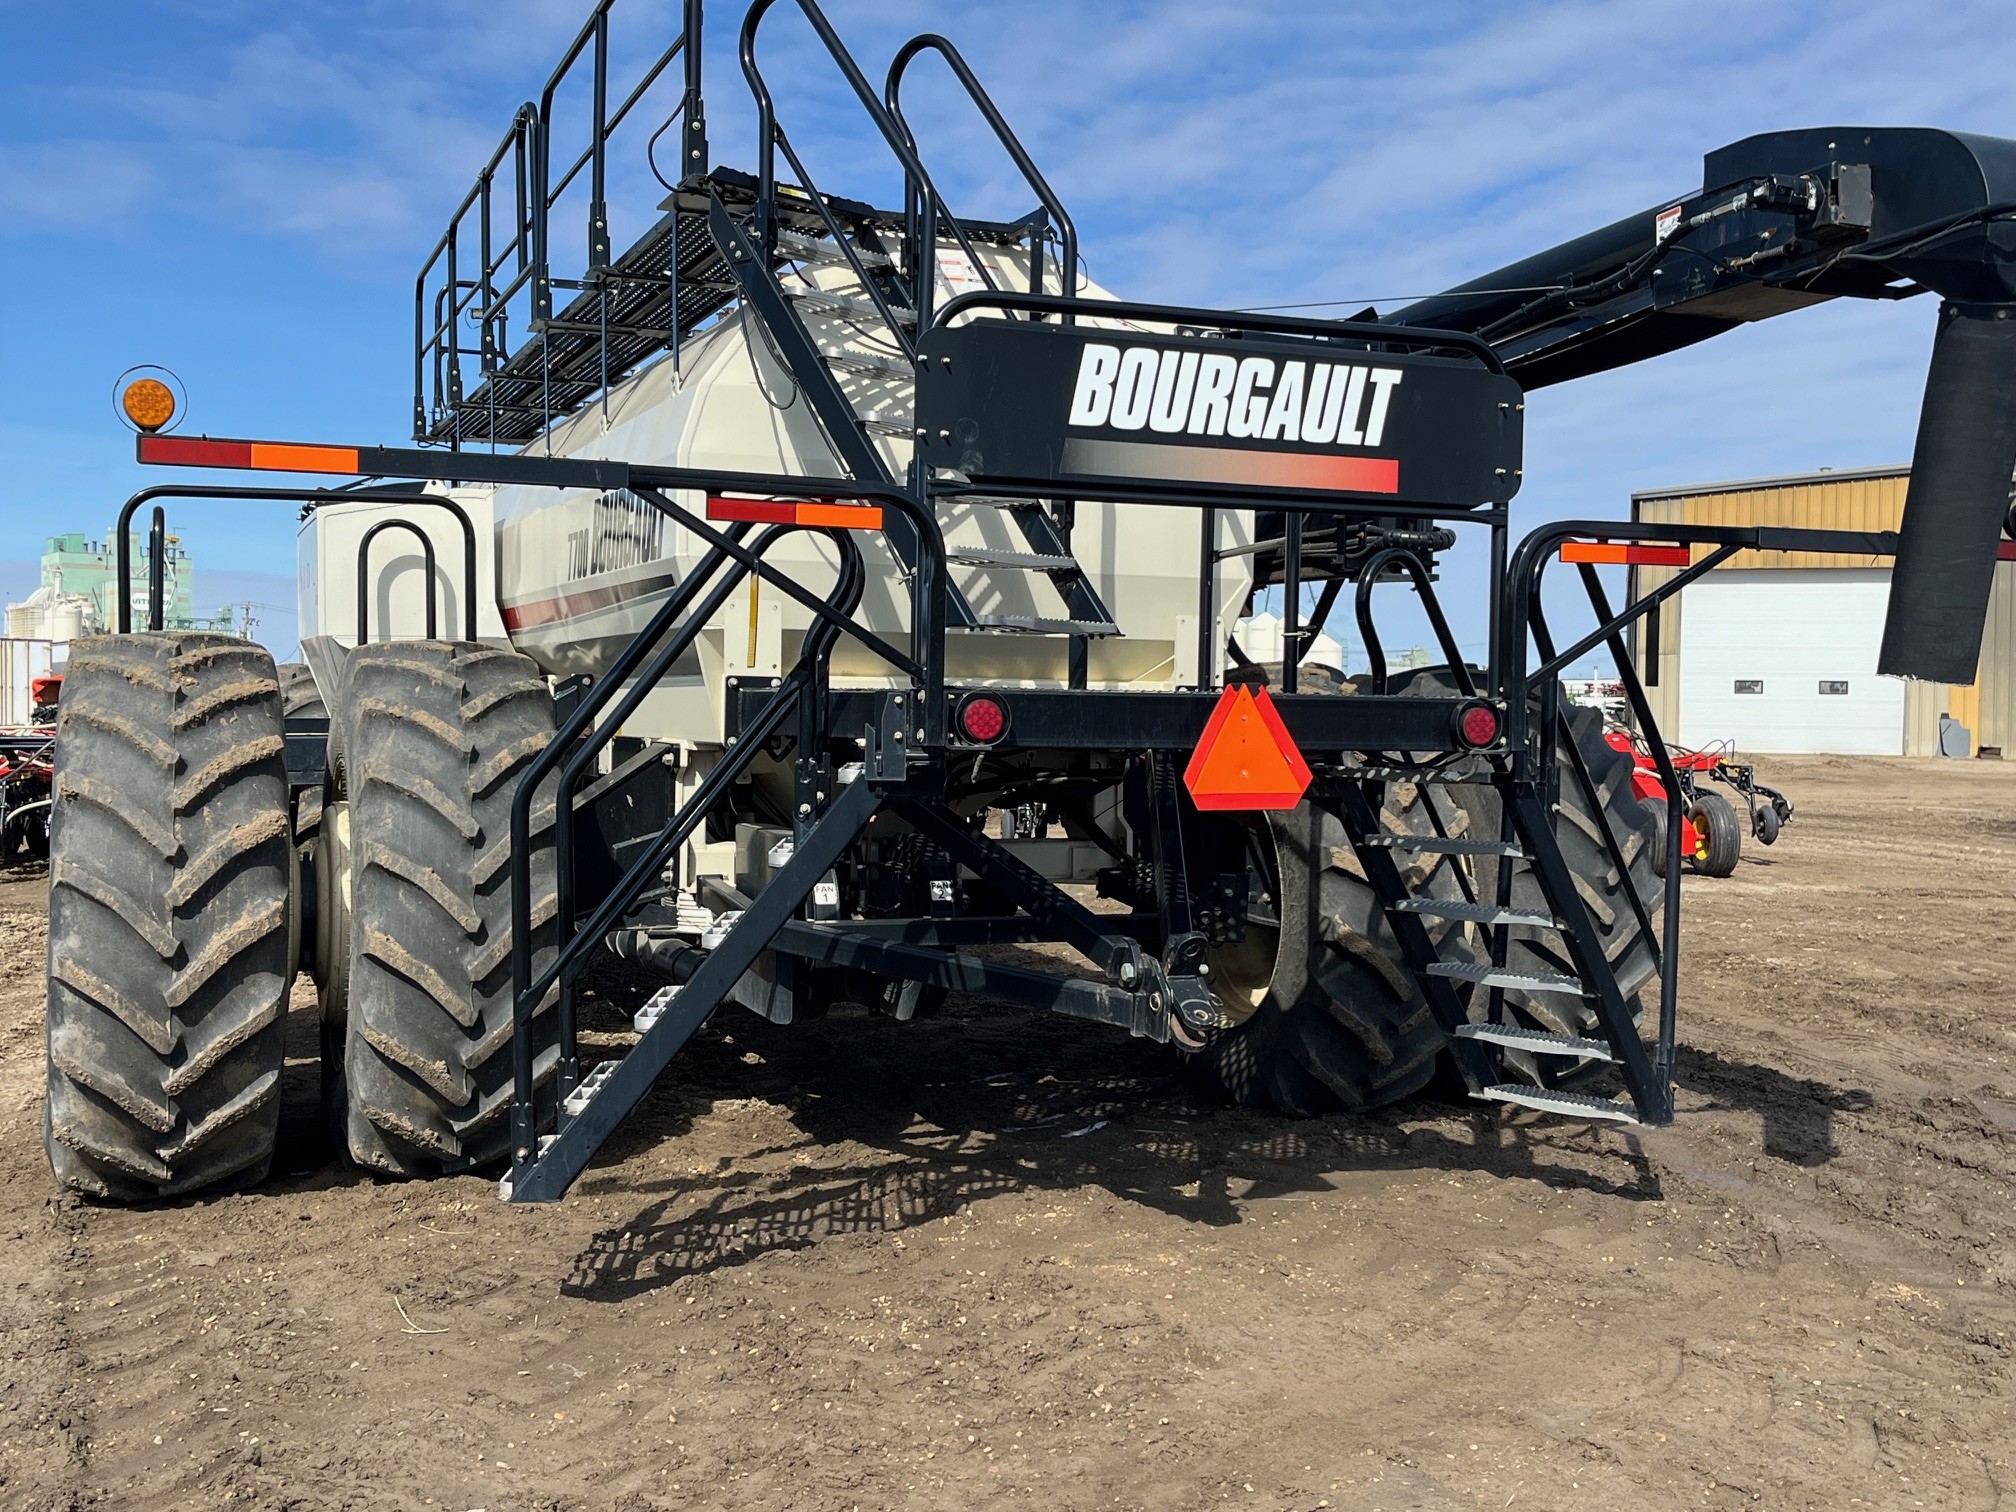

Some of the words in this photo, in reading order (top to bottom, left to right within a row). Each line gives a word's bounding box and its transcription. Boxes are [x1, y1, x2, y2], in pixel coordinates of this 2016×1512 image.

[1068, 343, 1403, 447] BOURGAULT
[815, 885, 834, 893] FAN
[938, 889, 945, 899] 2
